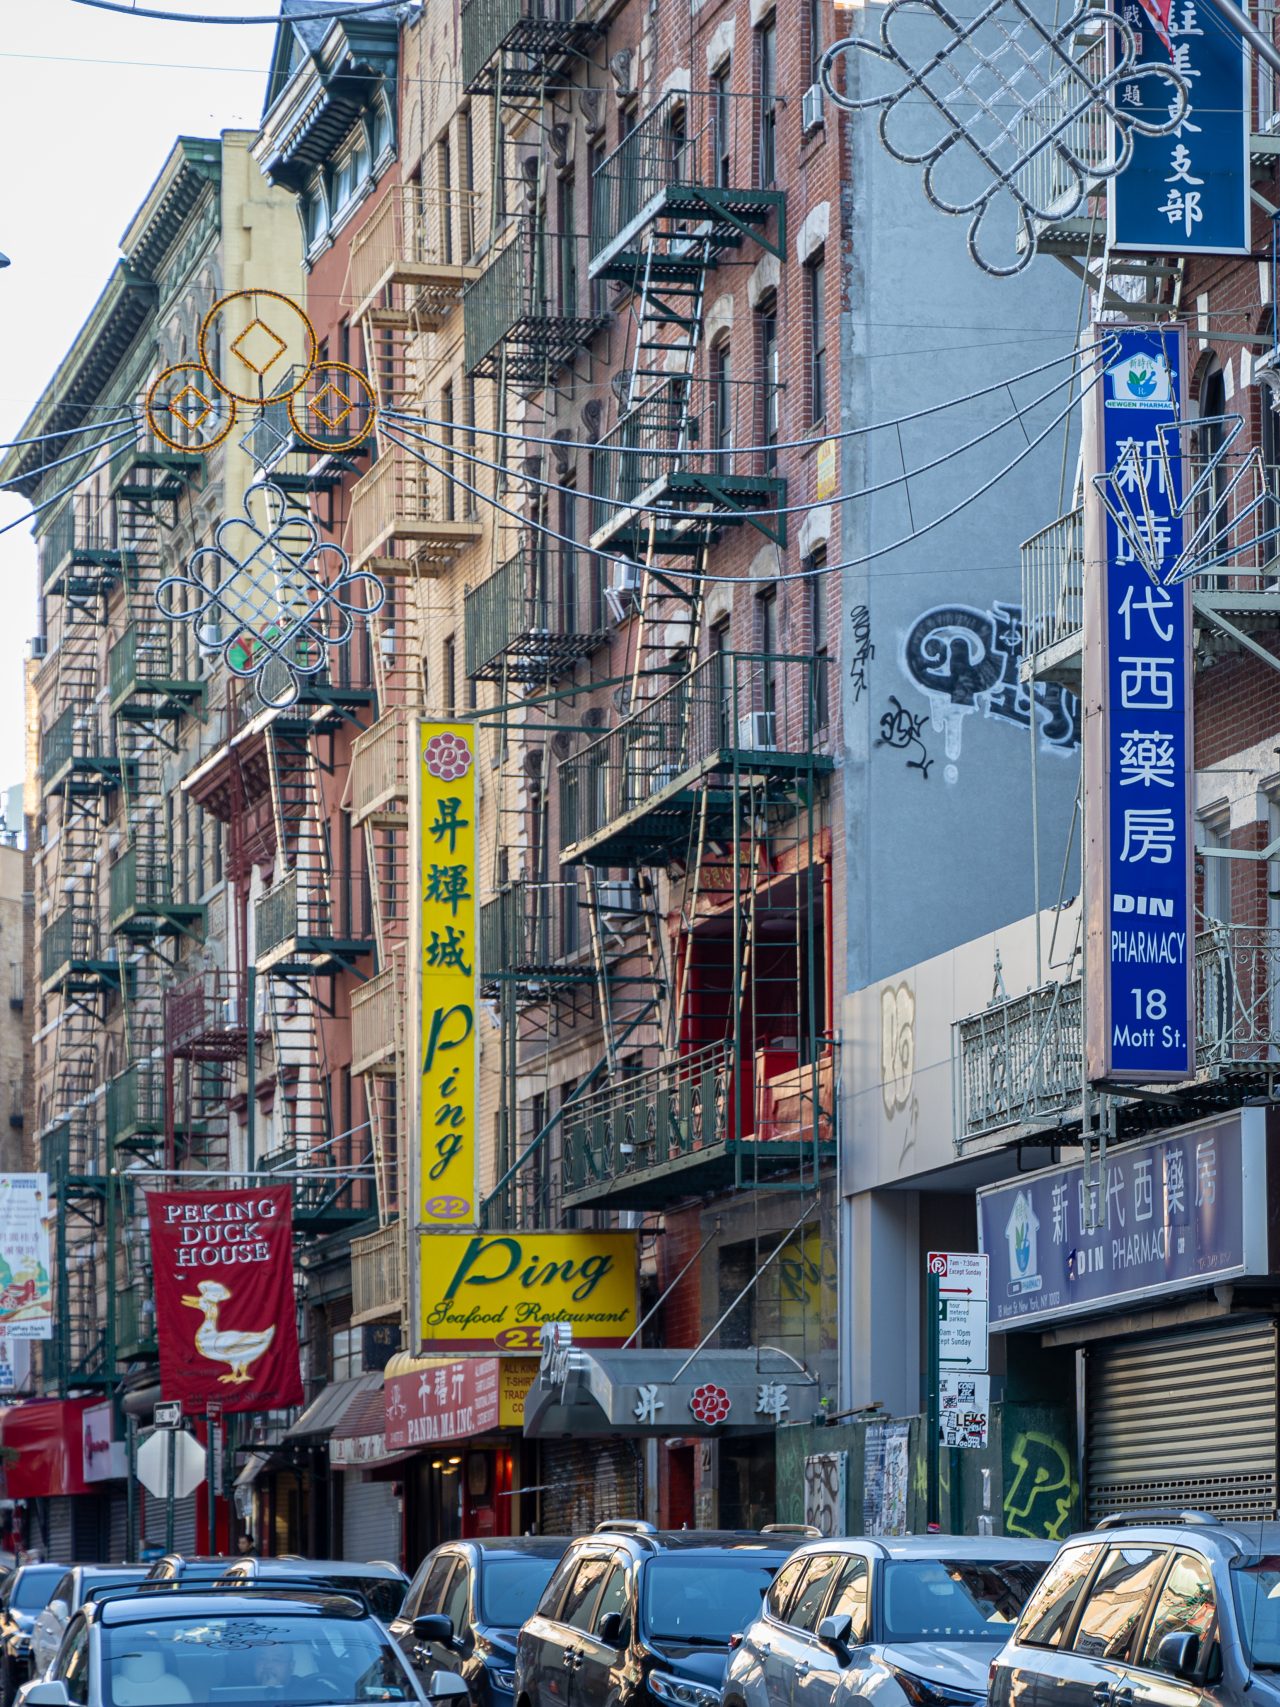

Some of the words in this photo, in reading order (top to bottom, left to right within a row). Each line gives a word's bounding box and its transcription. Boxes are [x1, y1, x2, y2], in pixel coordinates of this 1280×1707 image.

[1114, 436, 1176, 865] 新時代西藥房
[1113, 893, 1175, 918] DIN
[1111, 930, 1186, 965] PHARMACY
[1131, 988, 1168, 1021] 18
[1113, 1024, 1156, 1048] Mott
[1161, 1026, 1187, 1049] St.
[423, 1004, 474, 1181] Ping
[163, 1199, 277, 1225] PEKING
[431, 1200, 465, 1215] 22
[178, 1221, 263, 1246] DUCK
[173, 1242, 272, 1268] HOUSE
[1076, 1245, 1104, 1276] DIN
[1111, 1225, 1173, 1271] PHARMACY
[442, 1237, 615, 1303] Ping
[426, 1301, 508, 1331] Seafood
[514, 1302, 631, 1324] Restaurant
[407, 1416, 439, 1443] PANDA
[440, 1413, 455, 1438] MA
[456, 1406, 475, 1435] INC.
